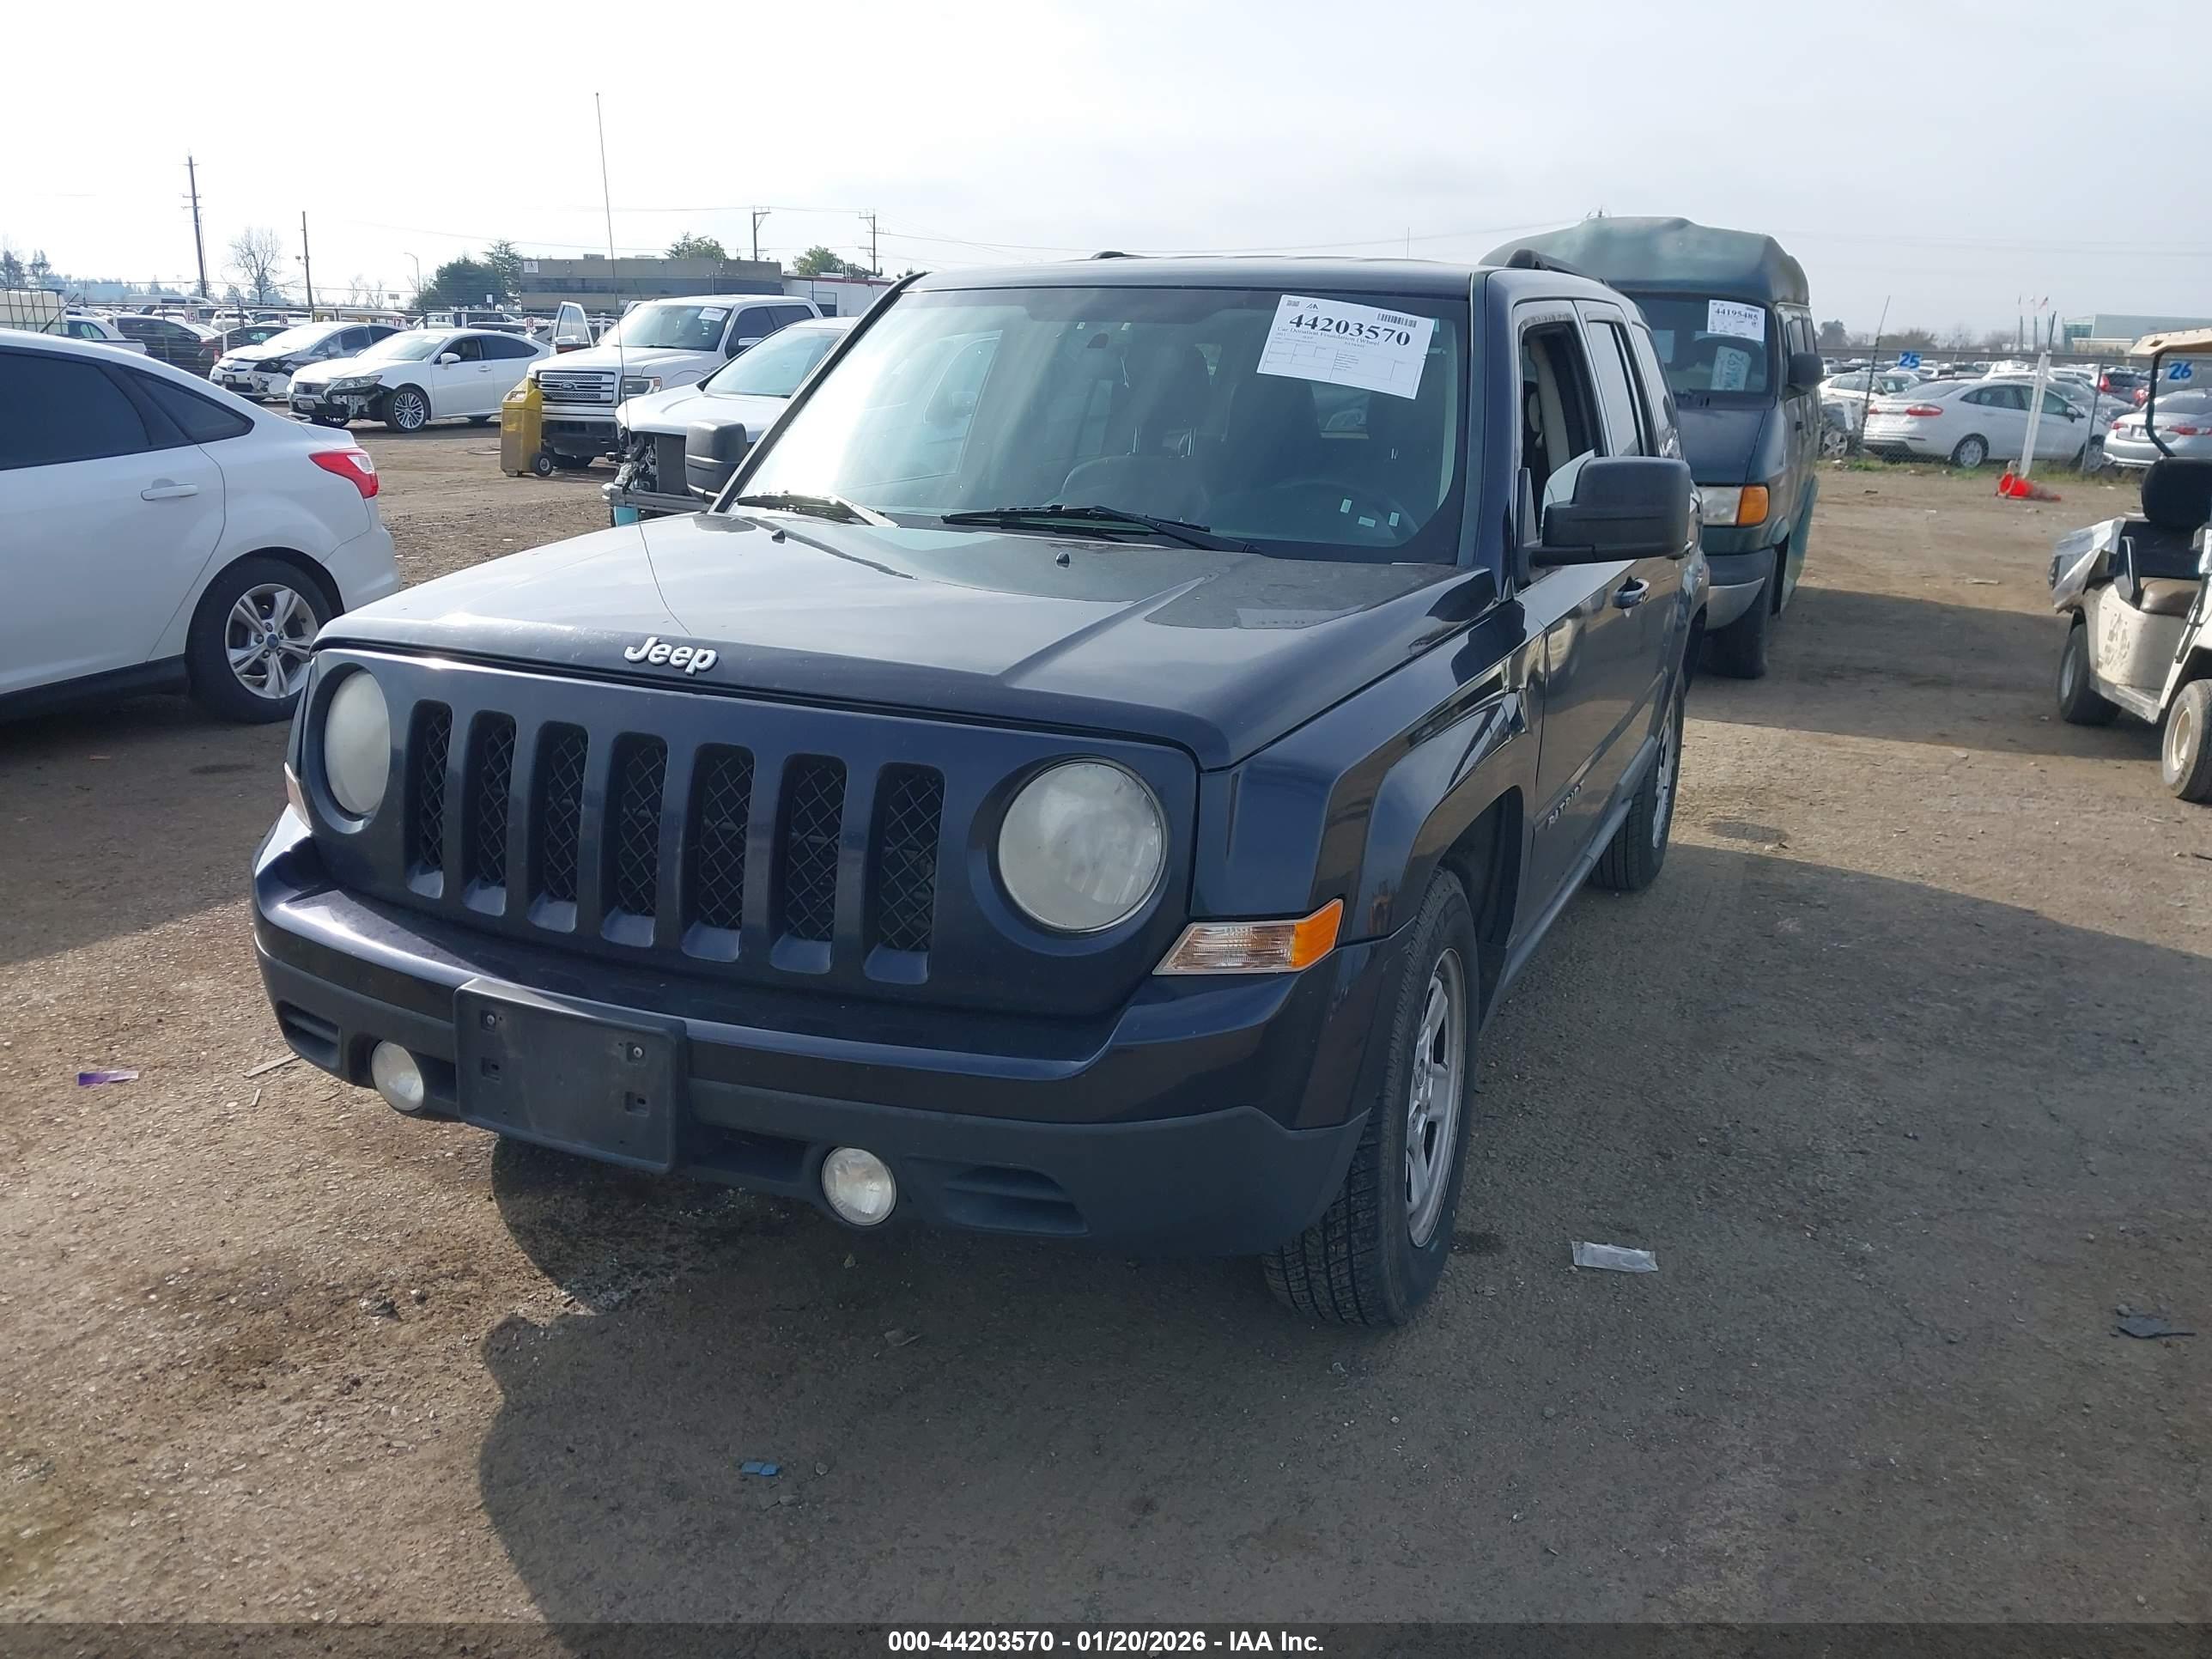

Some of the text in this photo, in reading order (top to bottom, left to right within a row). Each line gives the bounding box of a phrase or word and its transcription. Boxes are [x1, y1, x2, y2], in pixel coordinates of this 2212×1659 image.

[279, 315, 288, 325] 16
[1289, 313, 1411, 346] 44203570
[1899, 352, 1921, 369] 25
[2168, 362, 2193, 380] 26
[623, 636, 719, 676] Jeep
